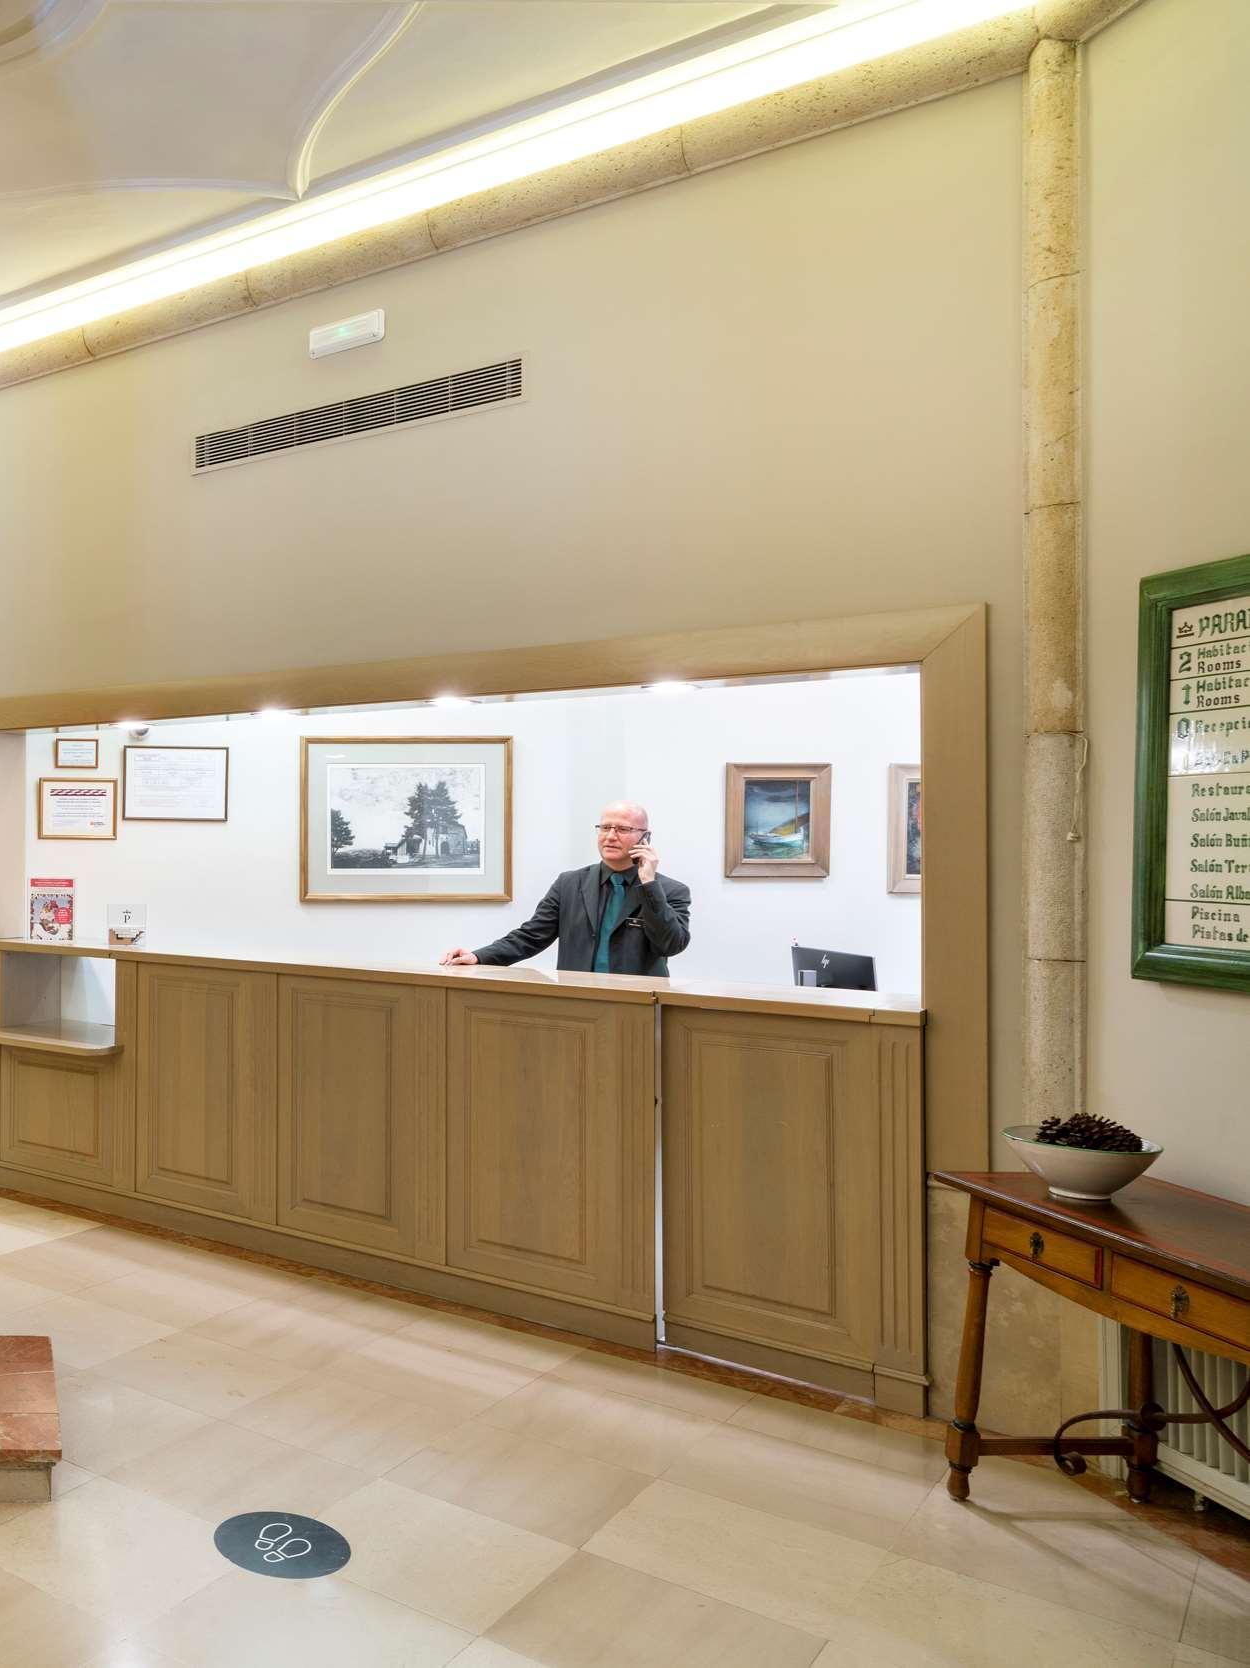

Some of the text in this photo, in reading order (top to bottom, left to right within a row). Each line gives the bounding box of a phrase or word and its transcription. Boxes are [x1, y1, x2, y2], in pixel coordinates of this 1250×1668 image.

[1198, 609, 1250, 638] PARA
[1179, 642, 1250, 673] 2 Habitac
[1198, 659, 1241, 673] Rooms
[1196, 694, 1240, 708] Rooms
[1195, 716, 1250, 737] Recepci
[1191, 807, 1221, 822] Salón
[1190, 833, 1250, 848] Salón Buñ
[1190, 858, 1222, 873] Salón
[1190, 883, 1222, 899] Salón
[1191, 906, 1240, 922] Piscina
[1192, 924, 1248, 942] Pistas de
